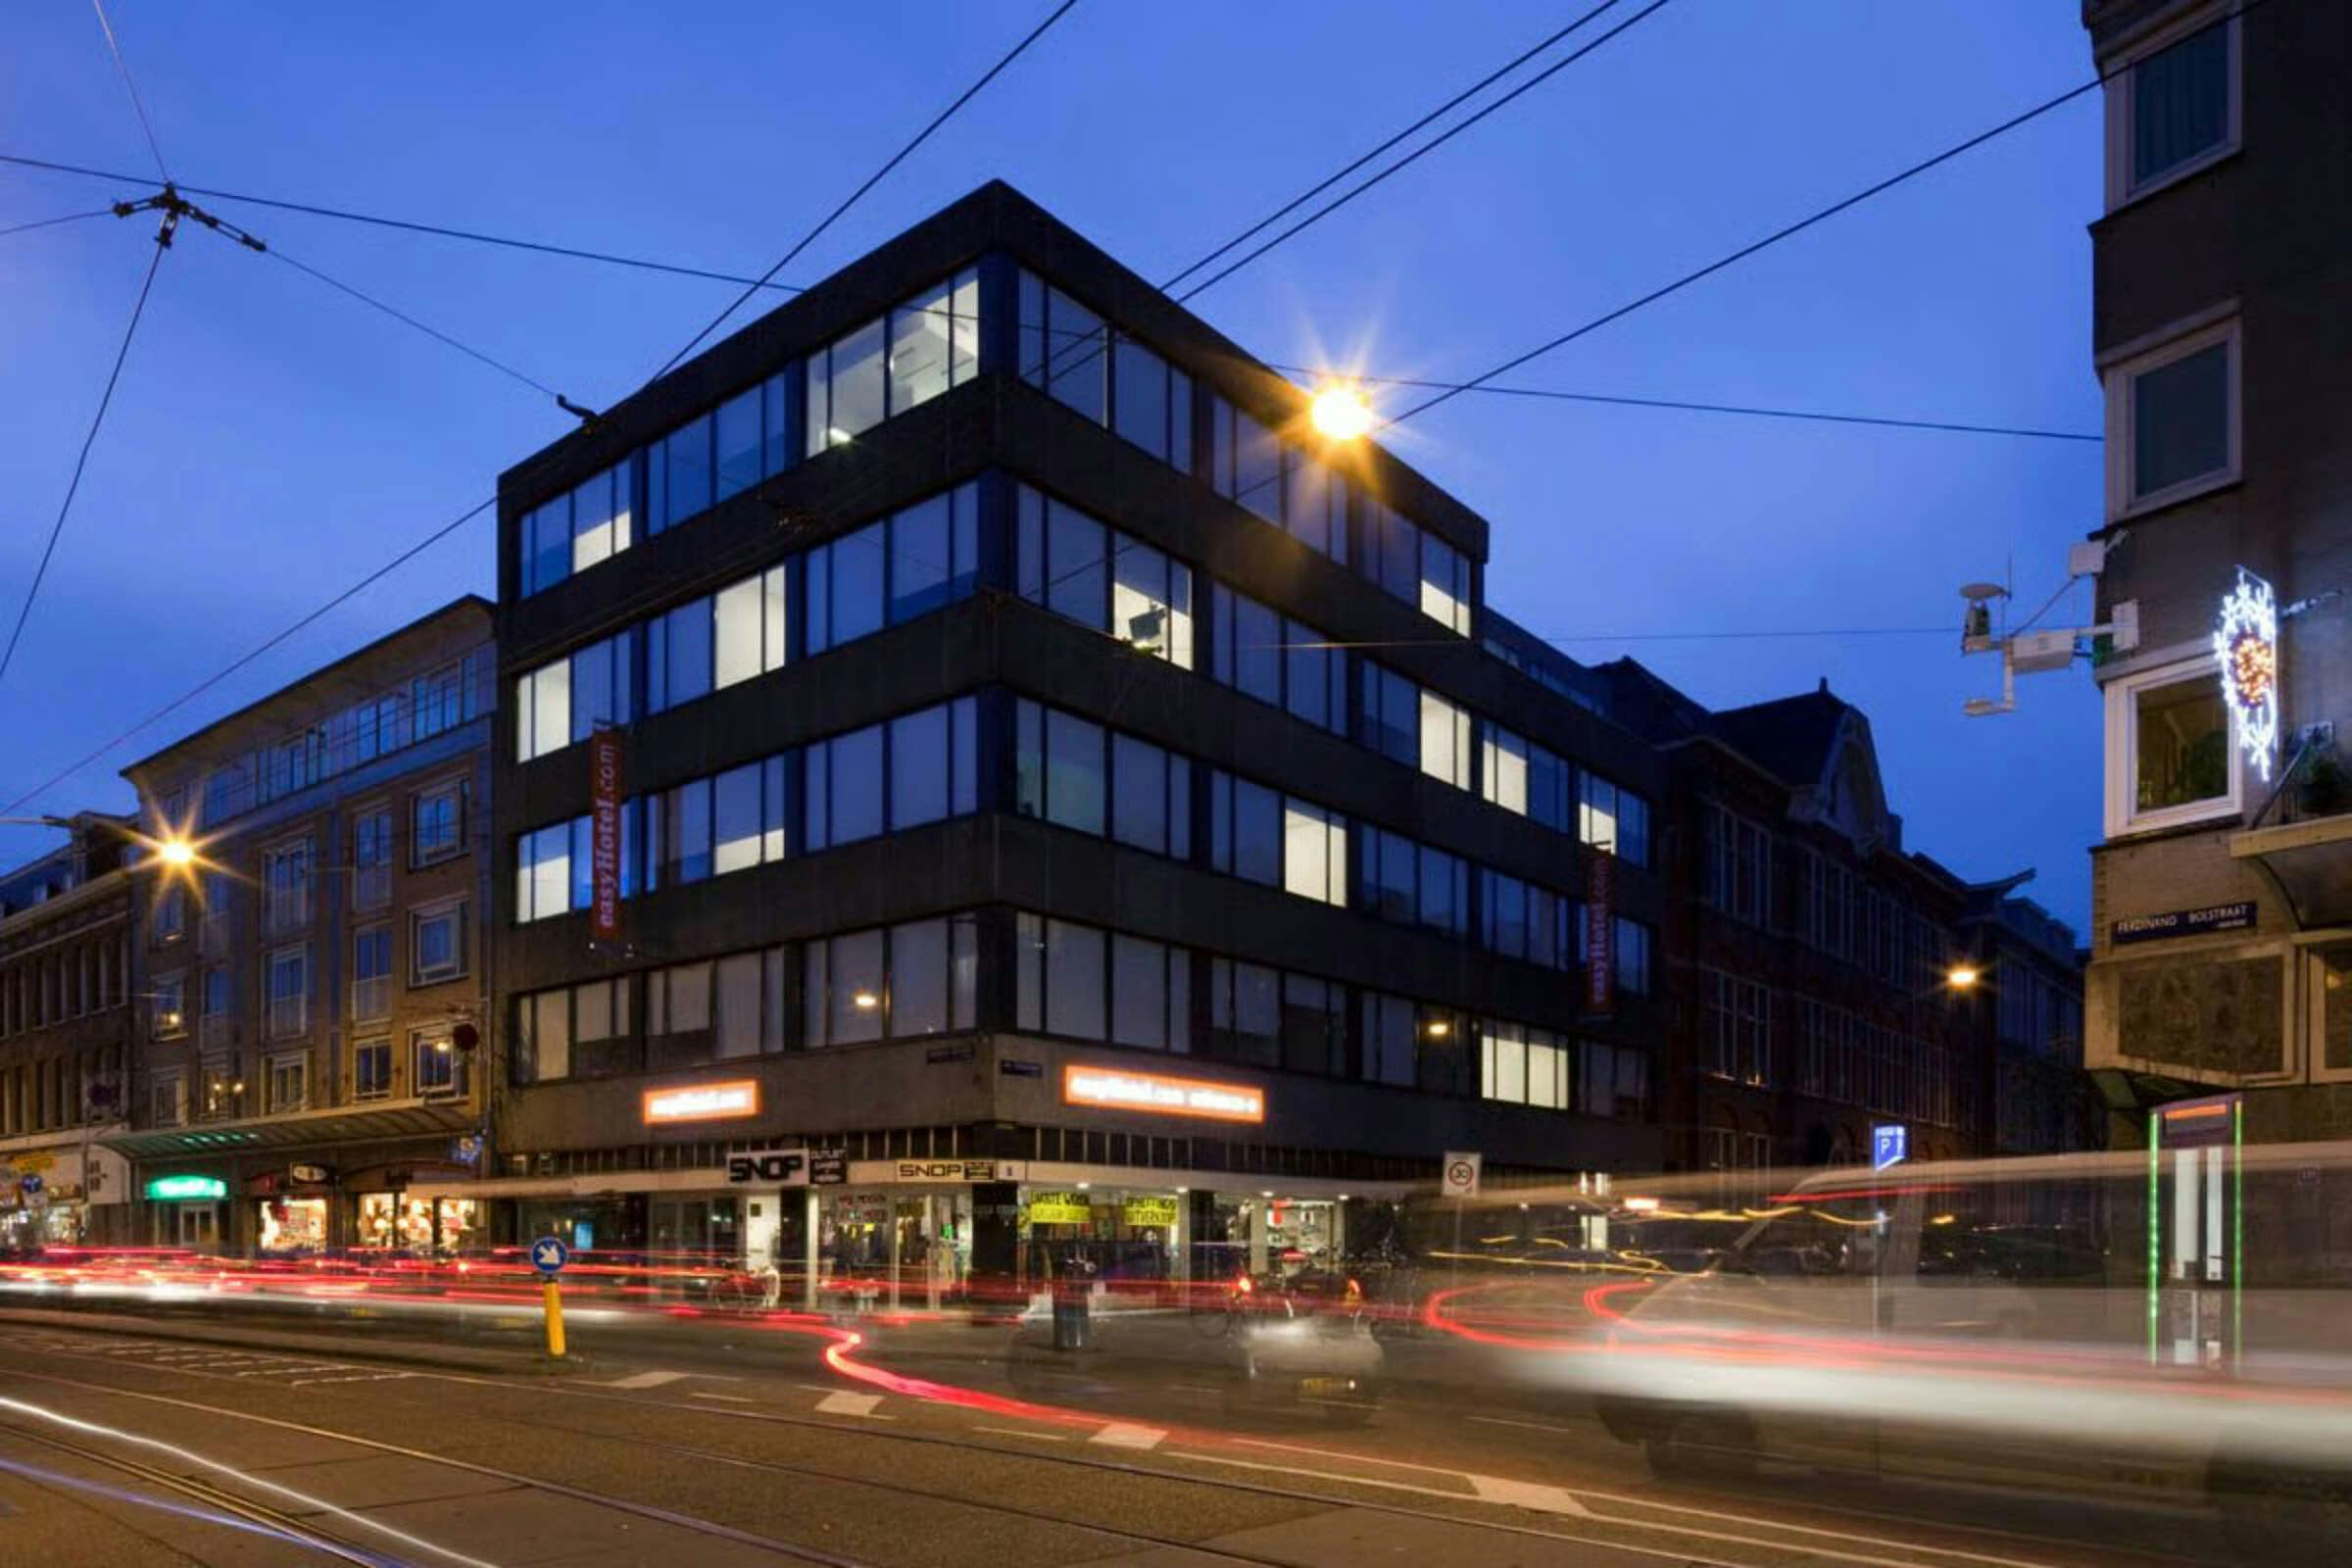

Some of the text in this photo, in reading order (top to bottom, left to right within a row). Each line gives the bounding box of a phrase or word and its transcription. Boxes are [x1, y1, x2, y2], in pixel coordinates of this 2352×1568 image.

[595, 745, 617, 926] easyHotel.com
[2117, 913, 2178, 934] FERDINAND
[2187, 905, 2248, 924] BOLSTRAAT
[728, 1155, 804, 1182] SNOP
[899, 1163, 962, 1177] SNOP
